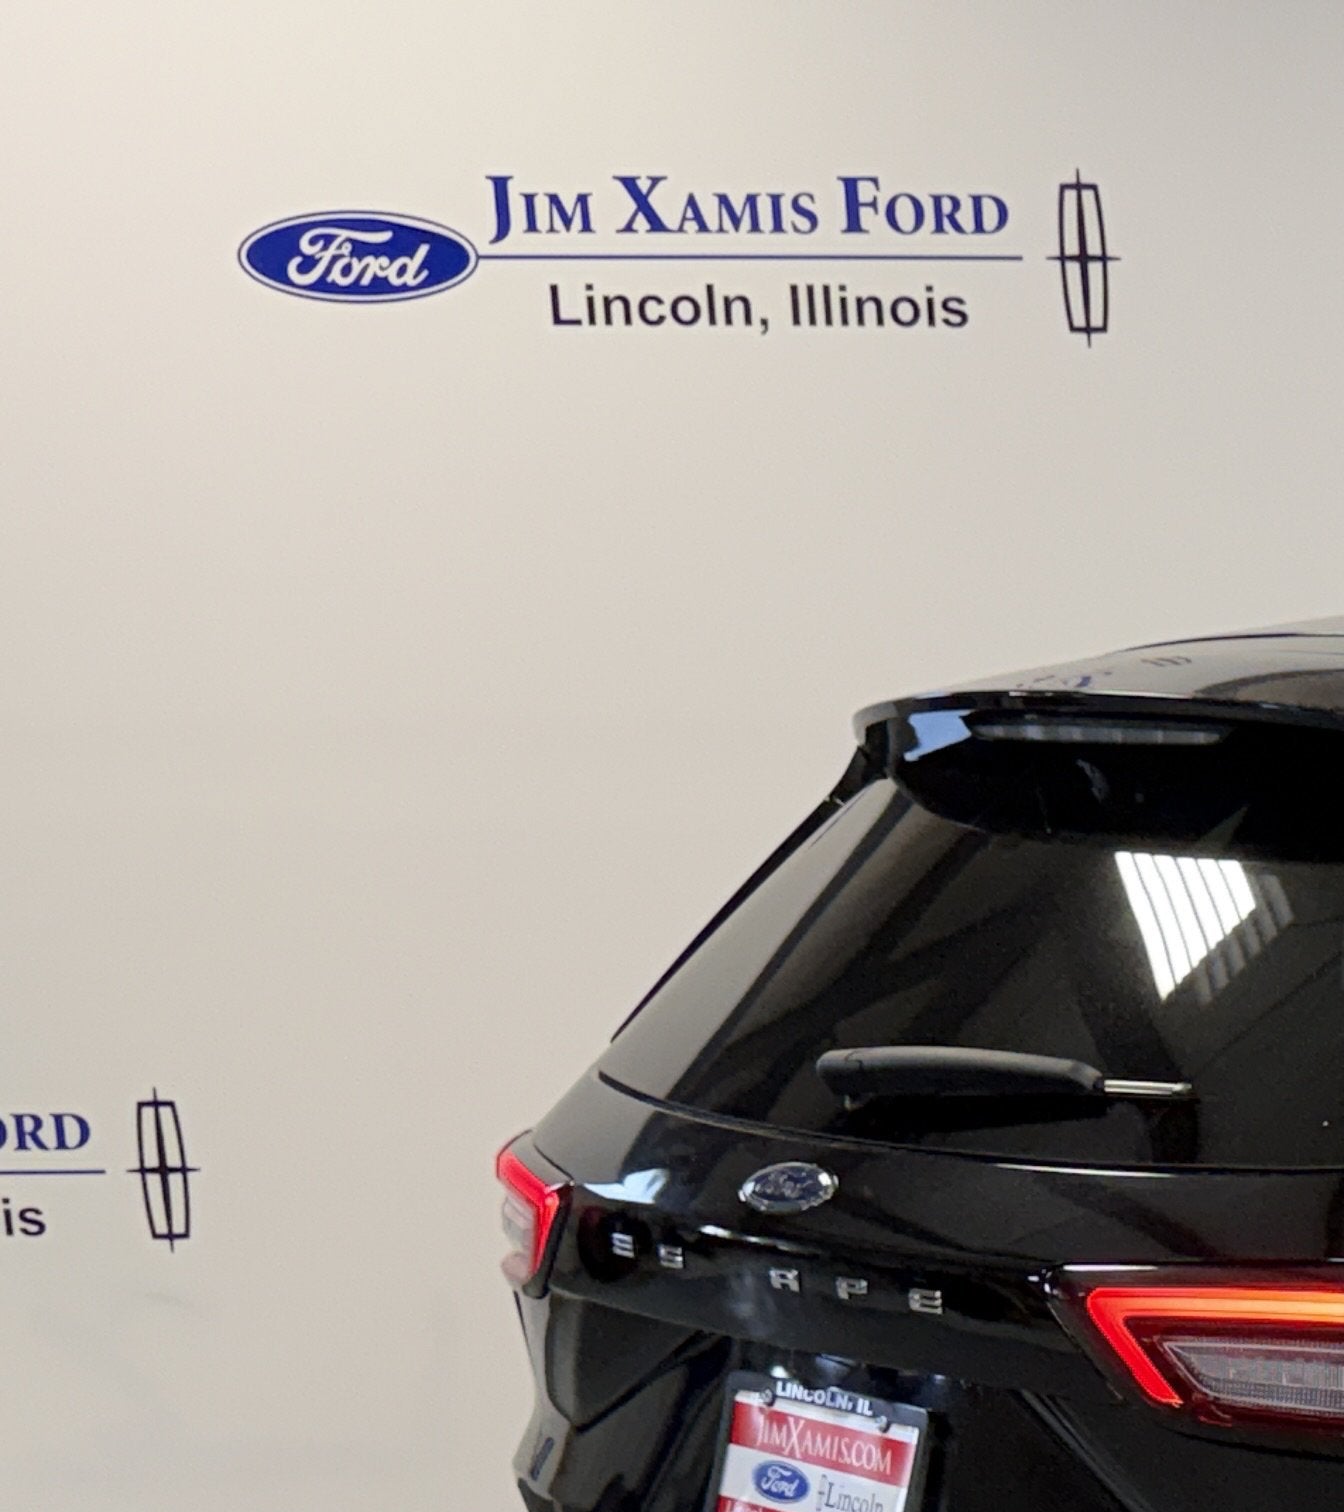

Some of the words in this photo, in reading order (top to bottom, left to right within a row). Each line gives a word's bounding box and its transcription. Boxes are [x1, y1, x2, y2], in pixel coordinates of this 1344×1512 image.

[486, 175, 594, 245] JIM
[613, 175, 818, 235] XAMIS
[837, 176, 1009, 235] FORD
[287, 226, 430, 286] Ford
[549, 283, 769, 335] Lincoln,
[789, 283, 969, 329] Illinois
[0, 1112, 91, 1152] RD
[611, 1231, 944, 1315] ESAPE
[775, 1380, 853, 1411] LINCOLN,
[855, 1397, 874, 1416] IL
[760, 1465, 800, 1497] Ford
